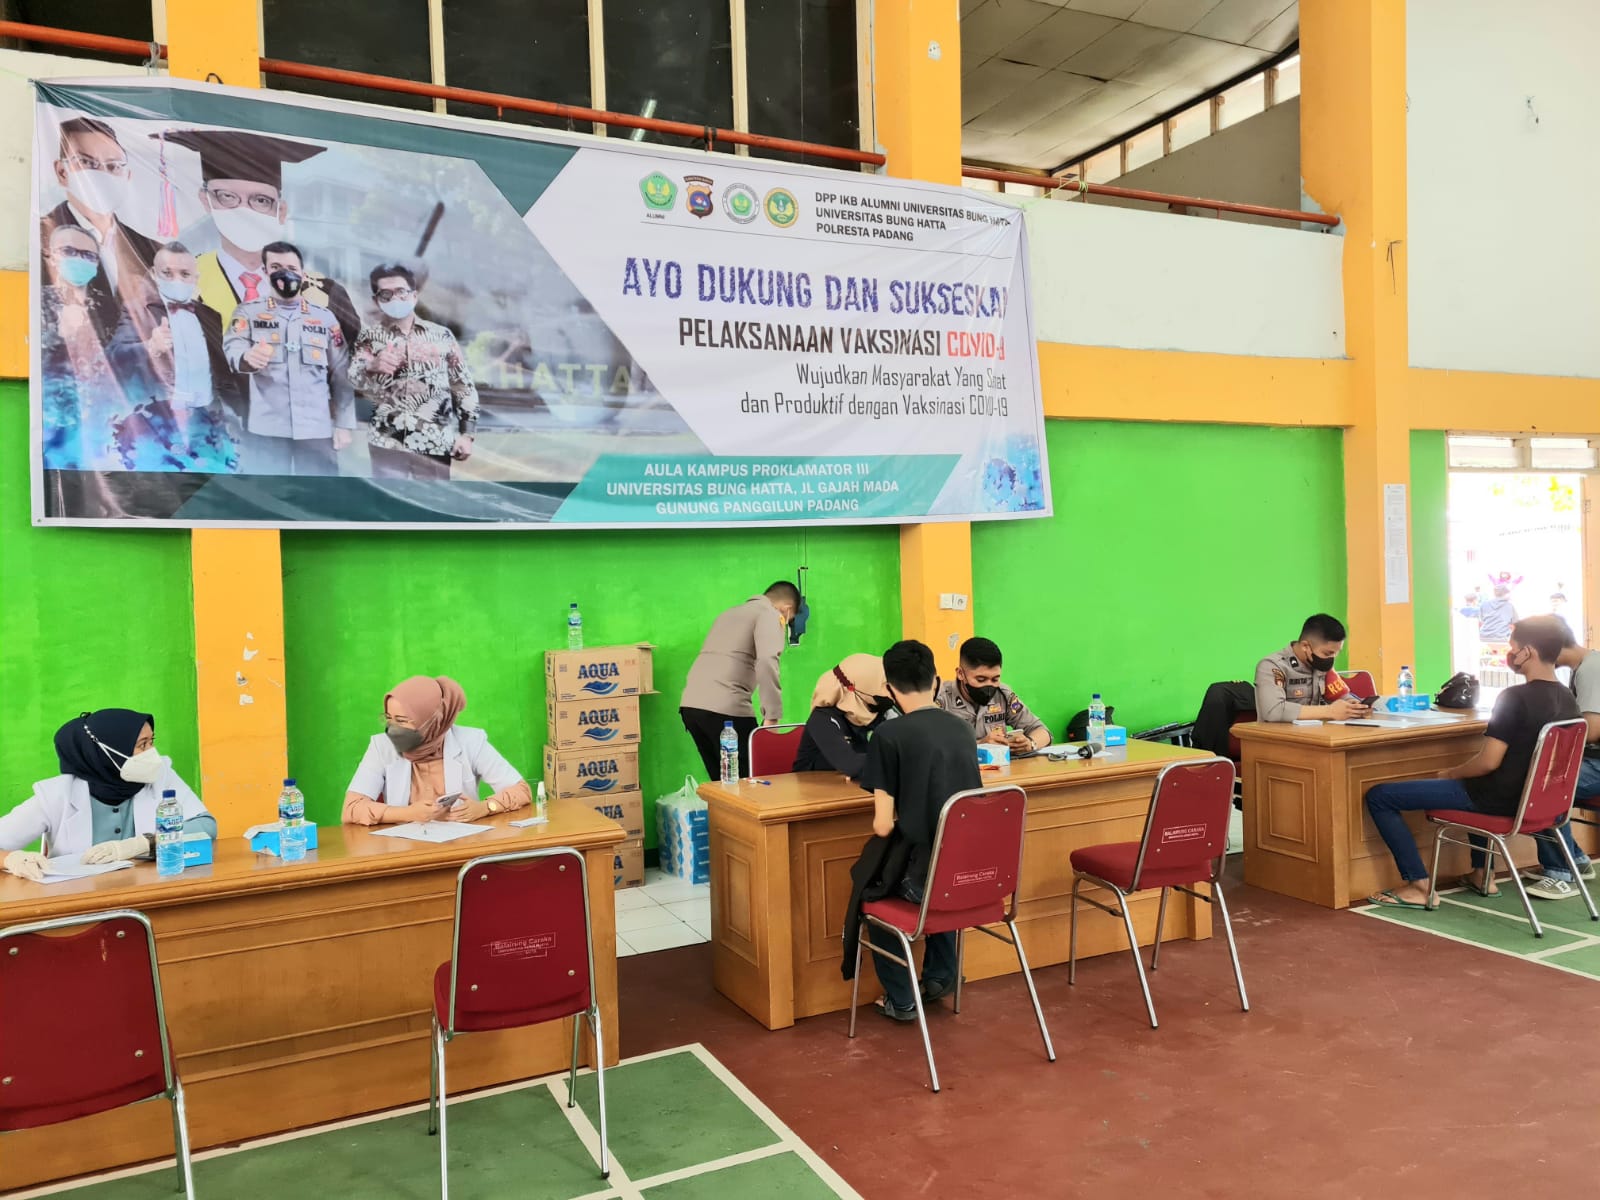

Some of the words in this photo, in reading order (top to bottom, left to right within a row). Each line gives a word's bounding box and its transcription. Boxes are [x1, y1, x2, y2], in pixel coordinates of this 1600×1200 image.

[815, 192, 837, 204] DPP
[839, 195, 858, 206] IKB
[861, 197, 900, 211] ALUMNI
[903, 202, 965, 219] UNIVERSITAS
[966, 210, 988, 223] BUNG
[815, 207, 883, 224] UNIVERSITAS
[886, 214, 914, 227] BUNG
[917, 218, 946, 230] HATTA
[816, 223, 870, 237] POLRESTA
[872, 229, 914, 241] PADANG
[622, 257, 682, 299] AYO
[697, 263, 812, 308] DUKUNG
[824, 274, 879, 313] DAN
[679, 317, 833, 354] PELAKSANAAN
[840, 327, 941, 356] VAKSINASI
[796, 362, 868, 389] Wujudkan
[872, 364, 952, 391] Masyarakat
[954, 365, 984, 392] Yang
[740, 391, 769, 413] dan
[774, 392, 845, 415] Produktif
[848, 393, 898, 420] dengan
[902, 394, 965, 416] Vaksinasi
[644, 463, 683, 477] AULA
[687, 463, 748, 477] KAMPUS
[752, 463, 852, 477] PROKLAMATOR
[857, 463, 869, 475] III
[606, 482, 703, 496] UNIVERSITAS
[707, 482, 746, 496] BUNG
[751, 482, 797, 496] HATTA,
[801, 482, 814, 494] JL
[818, 481, 860, 494] GAJAH
[863, 480, 899, 493] MADA
[656, 501, 719, 515] GUNUNG
[723, 499, 802, 514] PANGGILUN
[807, 498, 859, 512] PADANG
[577, 662, 619, 680] AQUA
[577, 708, 620, 726] AQUA
[576, 759, 619, 777] AQUA
[594, 804, 624, 819] UA
